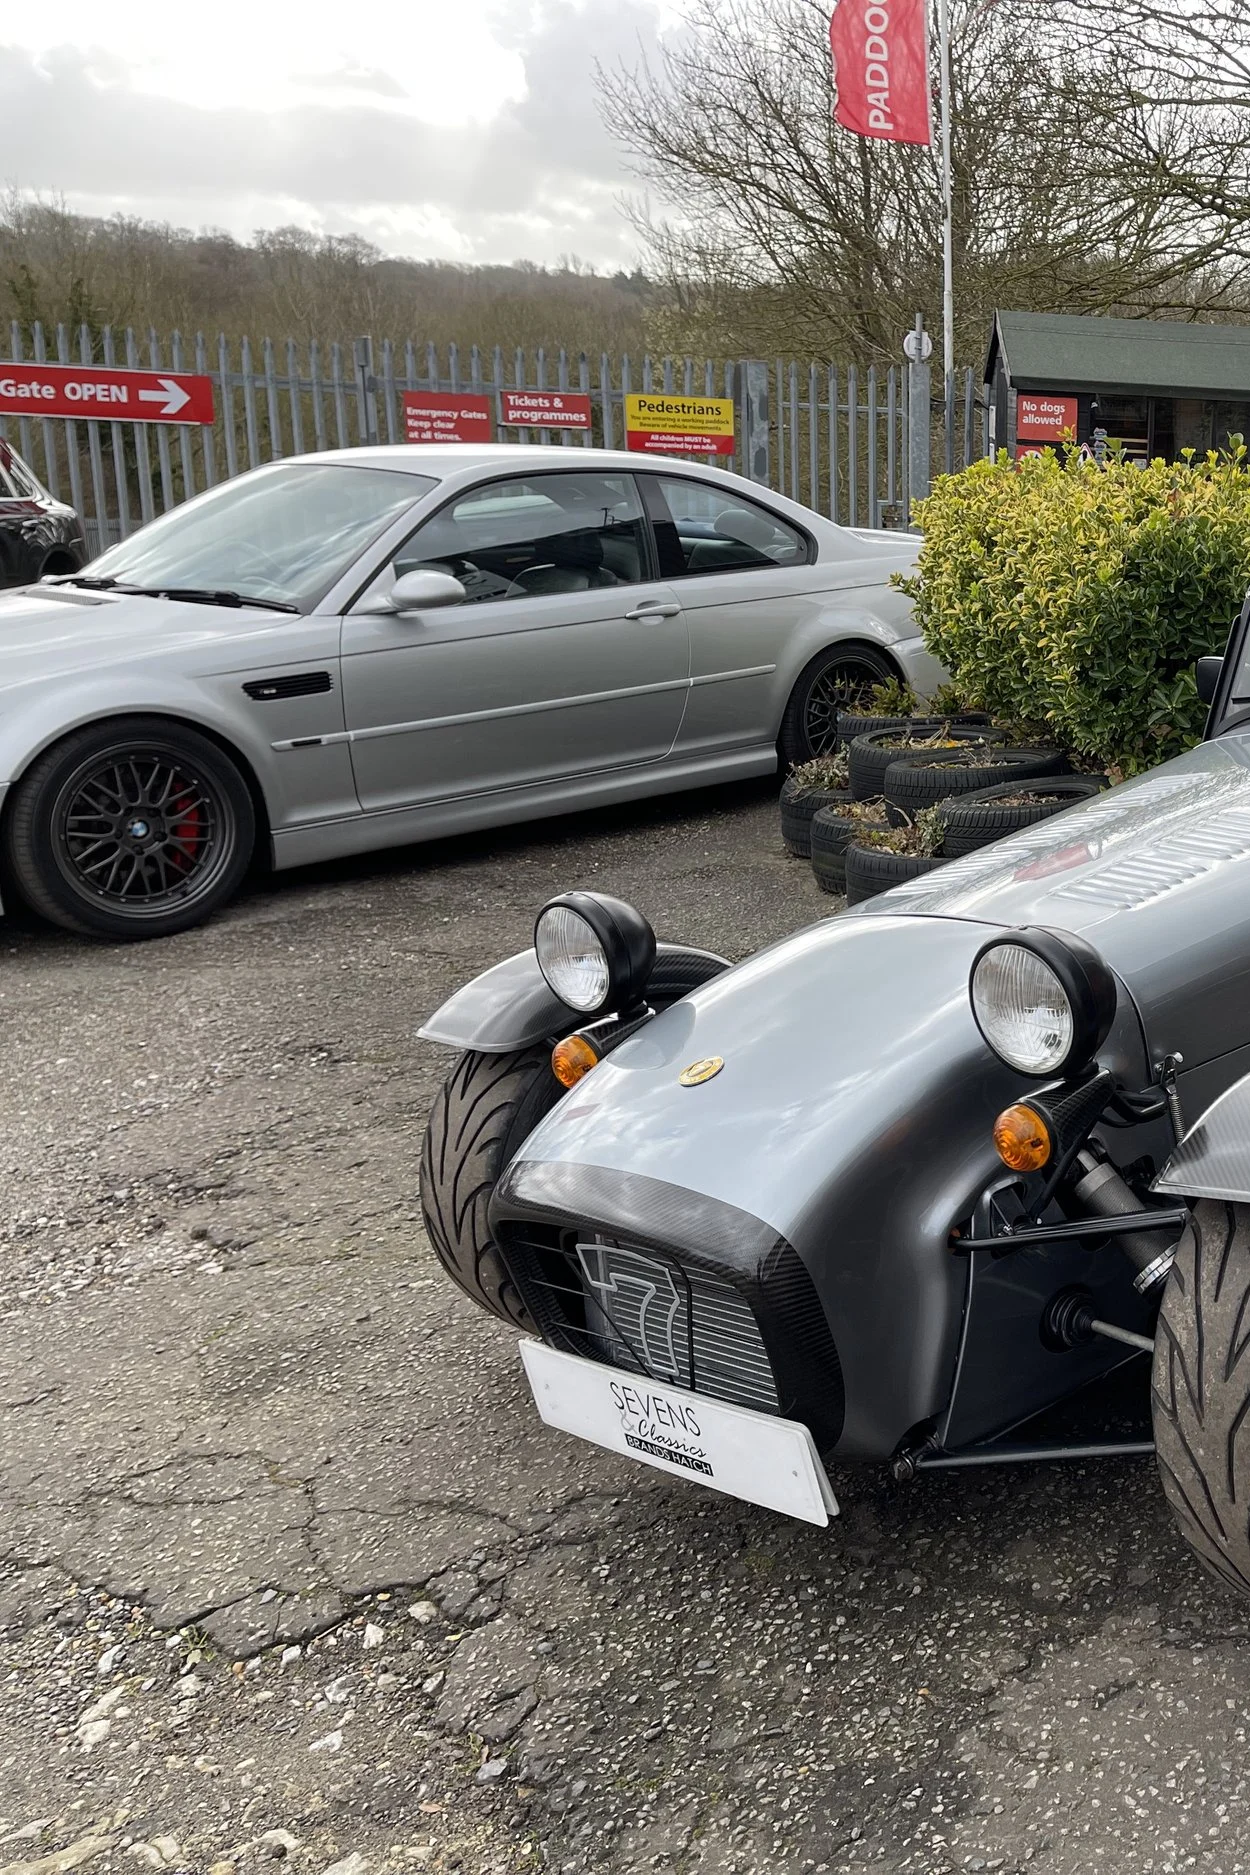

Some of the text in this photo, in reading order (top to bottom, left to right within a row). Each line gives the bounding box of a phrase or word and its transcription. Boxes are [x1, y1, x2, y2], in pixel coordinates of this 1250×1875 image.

[865, 0, 894, 130] PADDO
[0, 379, 128, 403] Gate OPEN
[507, 395, 563, 408] Tickets &
[638, 399, 722, 416] Pedestrians
[1022, 401, 1065, 414] No dogs
[407, 407, 487, 420] Emergency Gates
[508, 409, 587, 422] programmes
[1022, 413, 1062, 425] allowed
[408, 420, 455, 430] Keep clear
[421, 431, 432, 440] all
[434, 432, 462, 441] times.
[685, 435, 702, 443] MUST
[610, 1381, 701, 1437] SEVENS
[619, 1409, 707, 1458] & Classics
[627, 1436, 712, 1476] BRANDS HATCH
